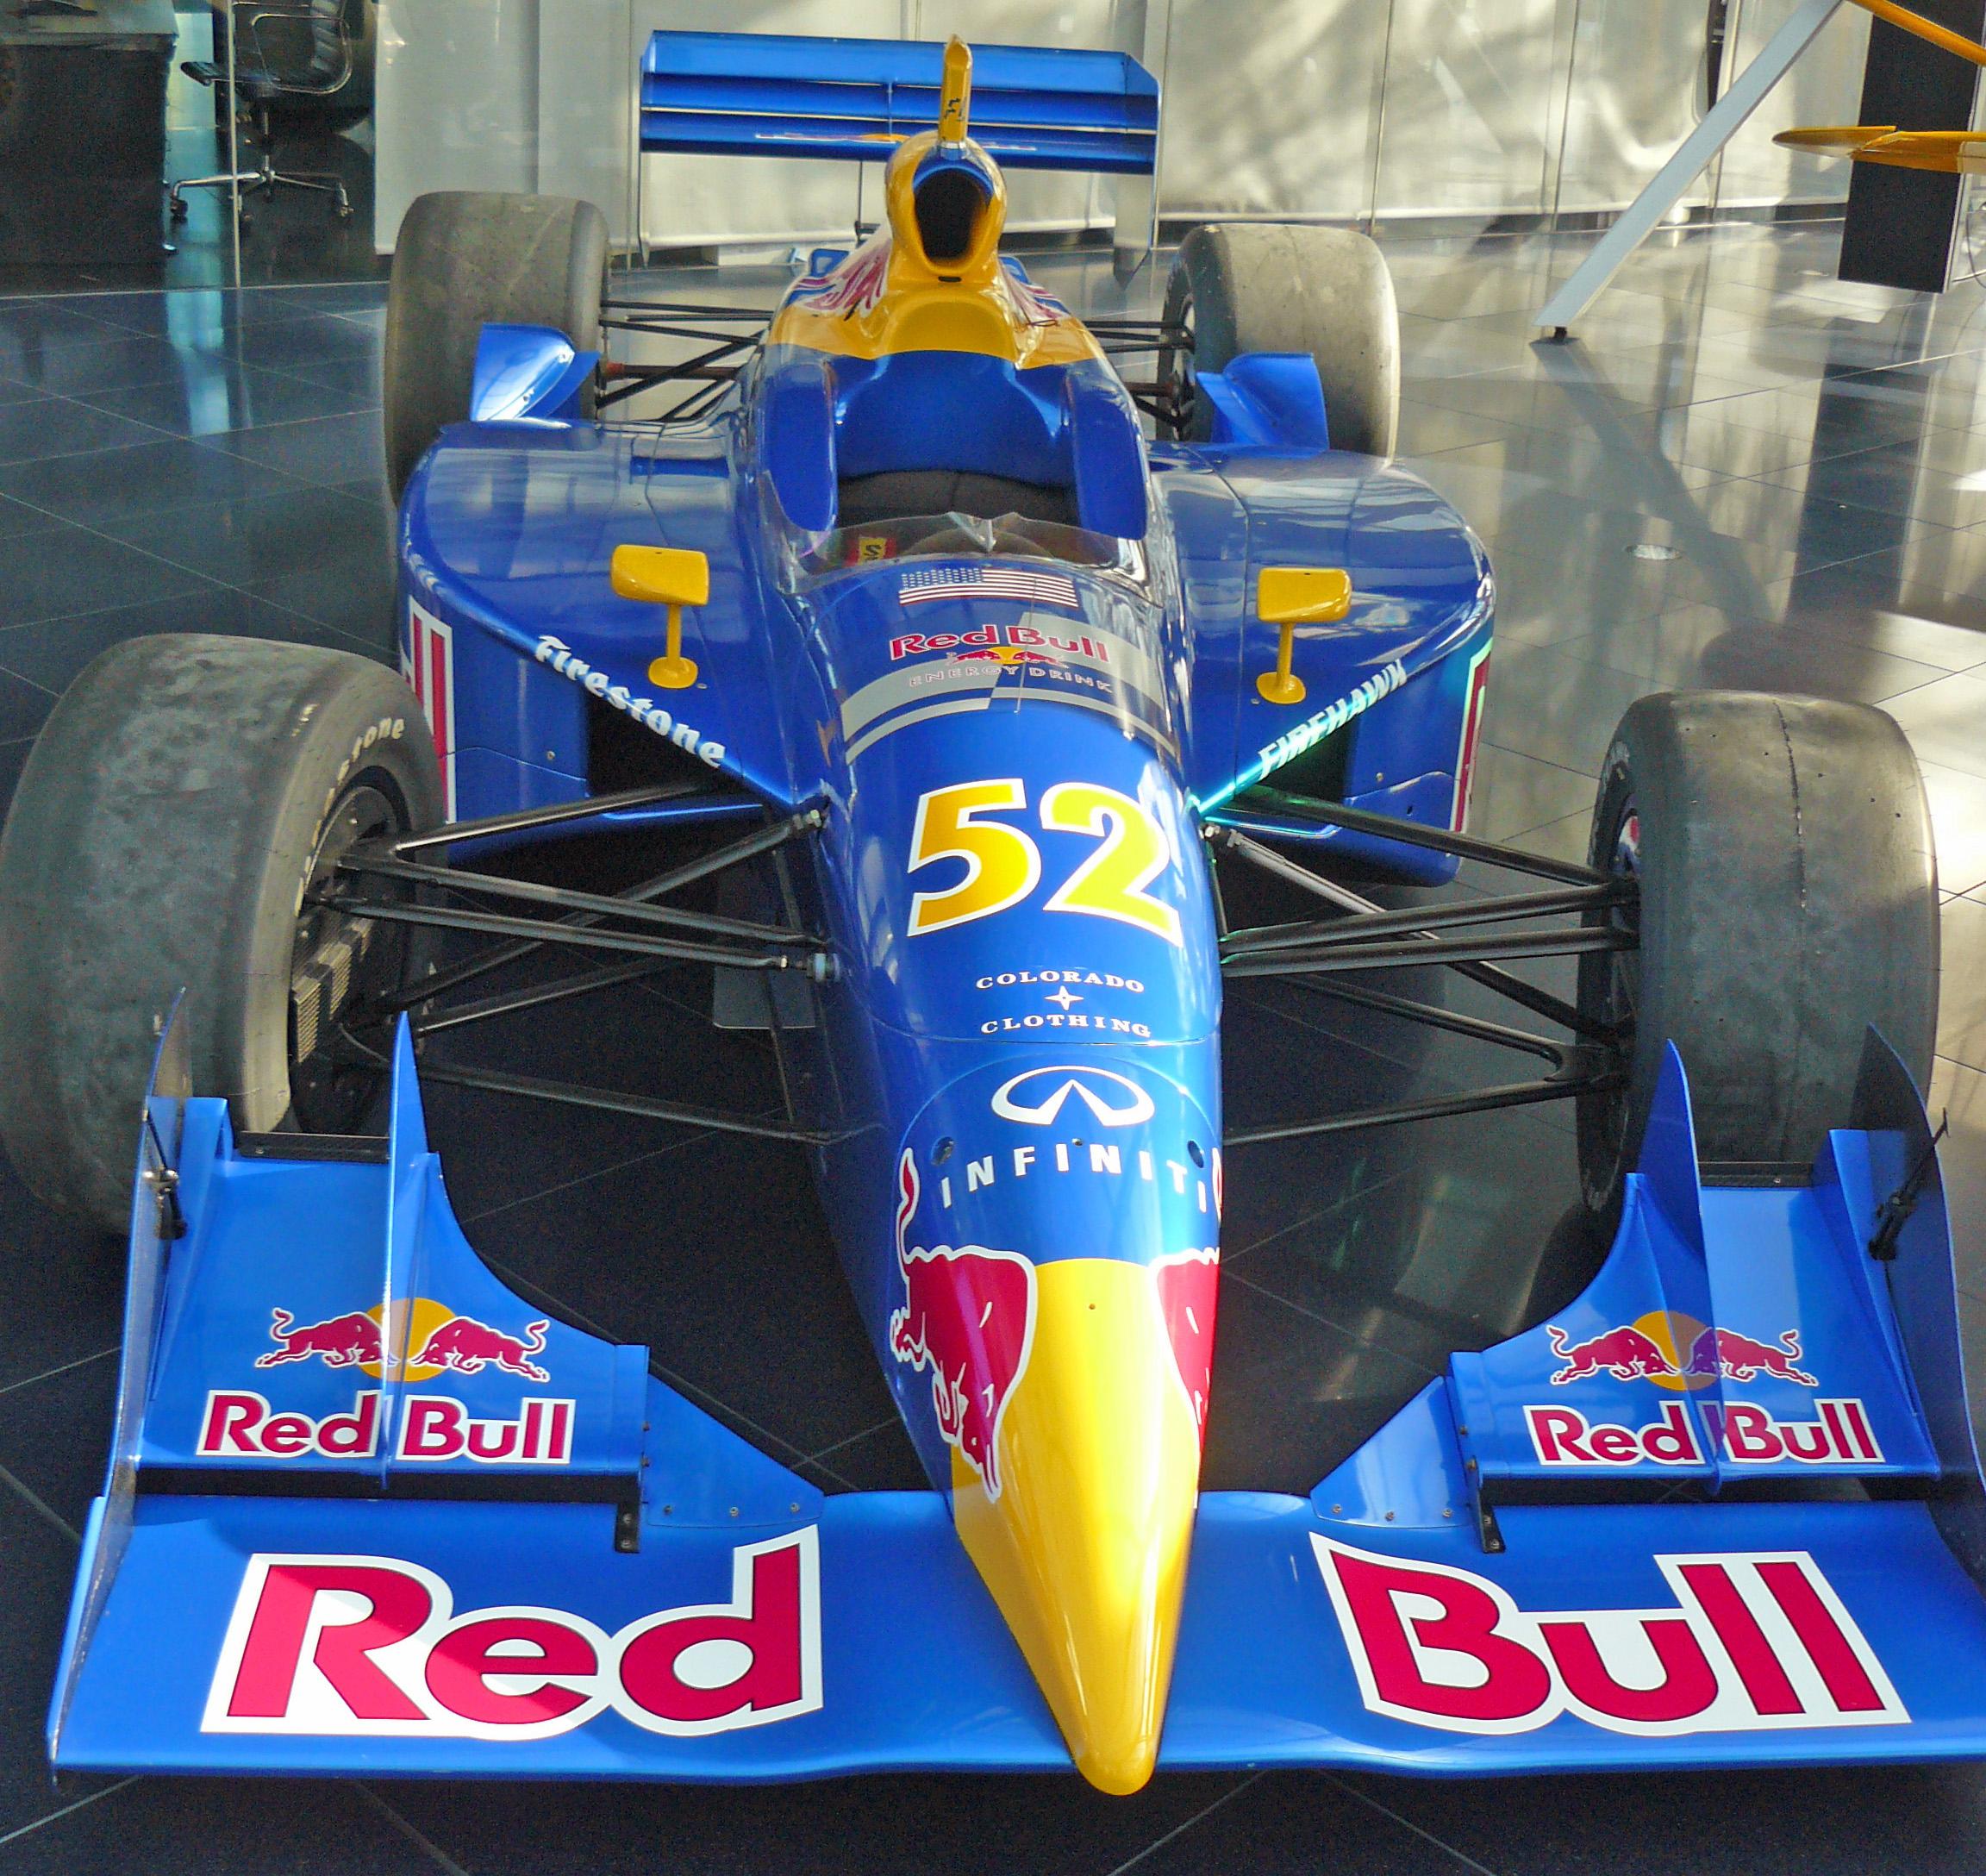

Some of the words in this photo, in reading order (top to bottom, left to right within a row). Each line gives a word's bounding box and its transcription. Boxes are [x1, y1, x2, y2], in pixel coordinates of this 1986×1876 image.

[890, 624, 999, 660] Red
[1006, 625, 1111, 662] Bull
[535, 635, 726, 768] Firestone
[909, 666, 1019, 688] ENERGY
[1028, 666, 1113, 693] DRINK
[908, 779, 1183, 948] 52
[976, 970, 1146, 993] COLORADO
[981, 1014, 1152, 1038] CLOTHING
[940, 1143, 1207, 1214] INFINITI
[200, 1391, 378, 1457] Red
[399, 1398, 572, 1462] Bull
[1526, 1403, 1702, 1464] Red
[1723, 1401, 1883, 1462] Bull
[219, 1538, 809, 1728] Red
[1324, 1547, 1889, 1725] Bull
